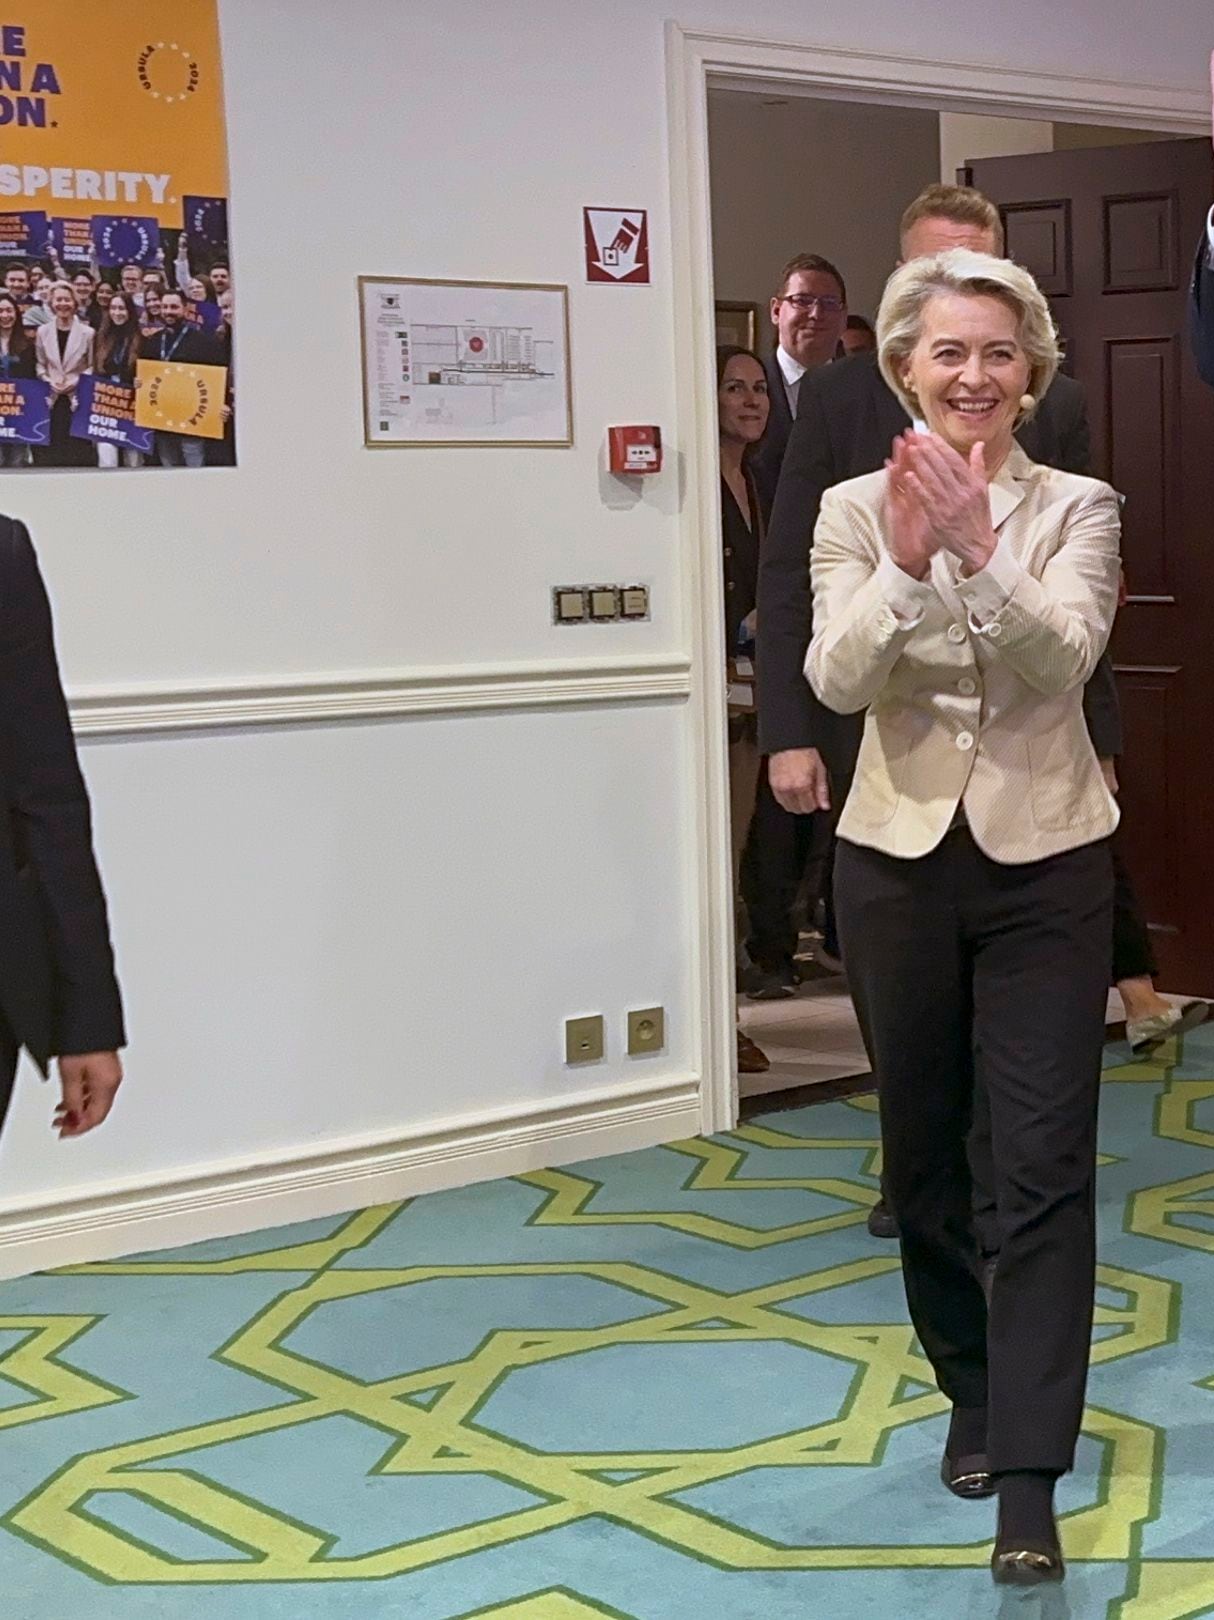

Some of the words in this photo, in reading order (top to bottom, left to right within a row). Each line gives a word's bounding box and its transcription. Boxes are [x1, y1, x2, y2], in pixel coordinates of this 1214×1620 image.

[30, 63, 62, 95] A
[0, 94, 58, 128] ON.
[0, 164, 177, 204] SPERITY.
[0, 382, 16, 393] RE
[94, 381, 131, 399] MORE
[93, 391, 129, 408] THAN
[89, 414, 118, 428] OUR
